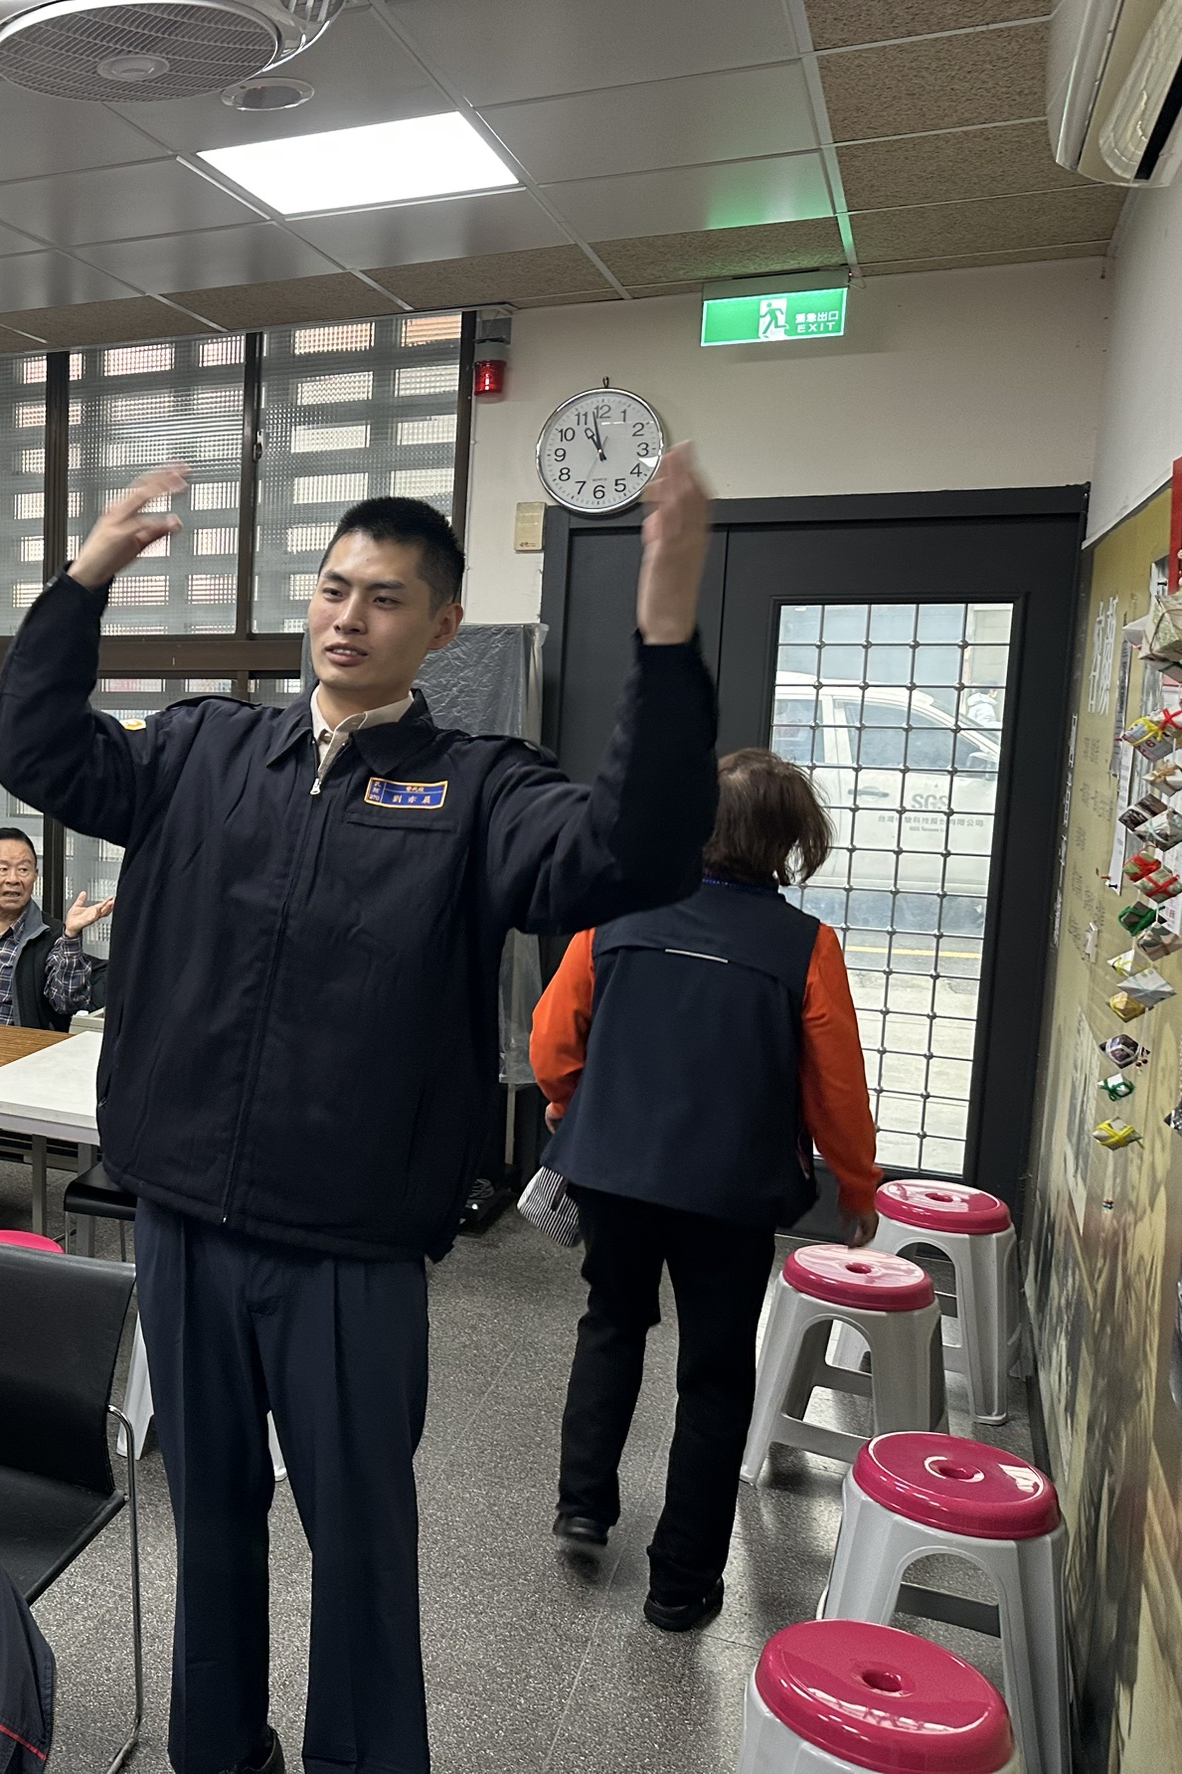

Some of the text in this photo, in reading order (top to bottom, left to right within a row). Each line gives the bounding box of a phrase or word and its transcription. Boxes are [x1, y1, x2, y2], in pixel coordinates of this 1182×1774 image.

[797, 322, 836, 333] EXIT
[575, 411, 588, 426] 11
[594, 404, 611, 419] 12
[621, 408, 627, 422] 1
[558, 427, 575, 442] 10
[632, 422, 645, 437] 2
[554, 448, 566, 462] 9
[636, 442, 649, 457] 3
[558, 467, 571, 482] 8
[629, 463, 643, 477] 4
[575, 481, 587, 495] 7
[593, 485, 605, 499] 6
[614, 478, 627, 493] 5
[911, 793, 950, 810] SGS
